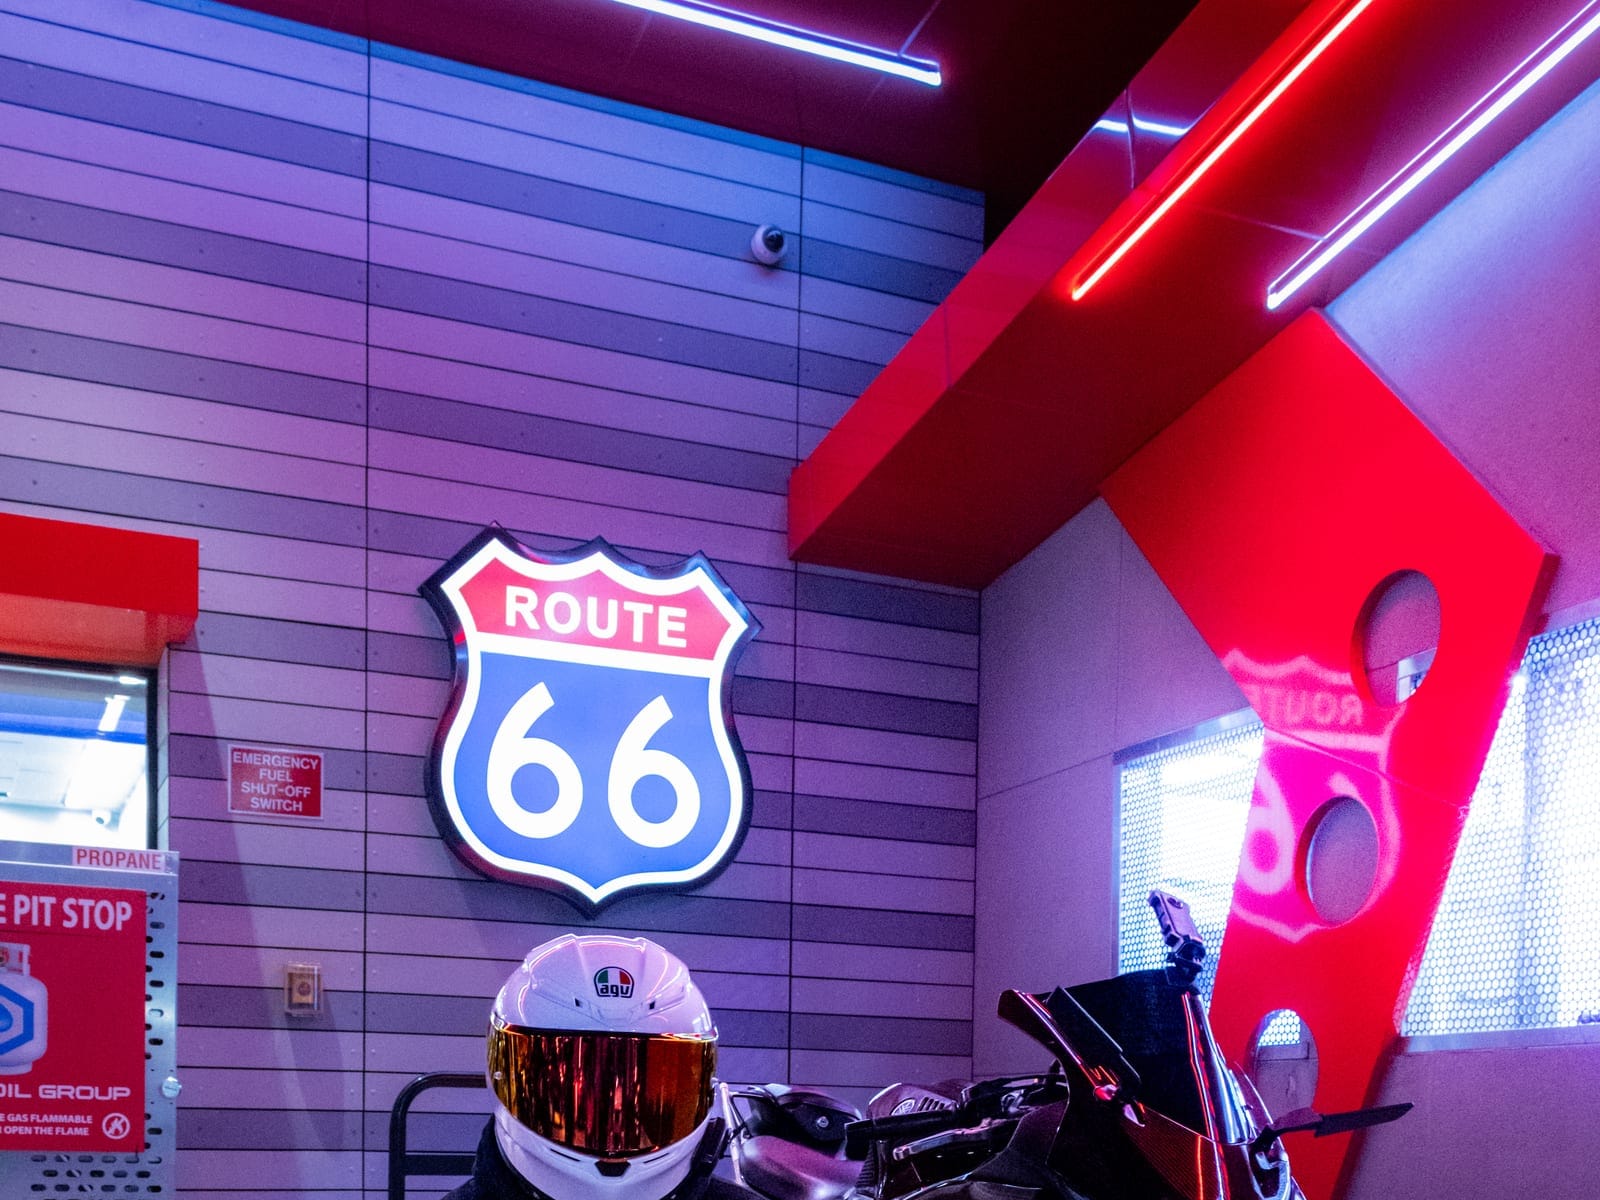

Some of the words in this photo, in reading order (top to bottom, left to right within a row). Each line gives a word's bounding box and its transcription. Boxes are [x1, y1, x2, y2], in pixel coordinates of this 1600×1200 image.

[505, 585, 687, 648] ROUTE
[233, 751, 318, 769] EMERGENCY
[487, 681, 700, 848] 66
[260, 768, 293, 782] FUEL
[241, 781, 311, 798] SHUT-OFF
[251, 797, 303, 812] SWITCH
[76, 848, 161, 870] PROPANE
[14, 894, 56, 927] PIT
[62, 898, 132, 931] STOP
[38, 1084, 131, 1101] GROUP
[7, 1113, 29, 1123] GAS
[30, 1114, 93, 1124] FLAMMABLE
[4, 1125, 32, 1135] OPEN
[33, 1126, 54, 1135] THE
[55, 1126, 89, 1136] FLAME
